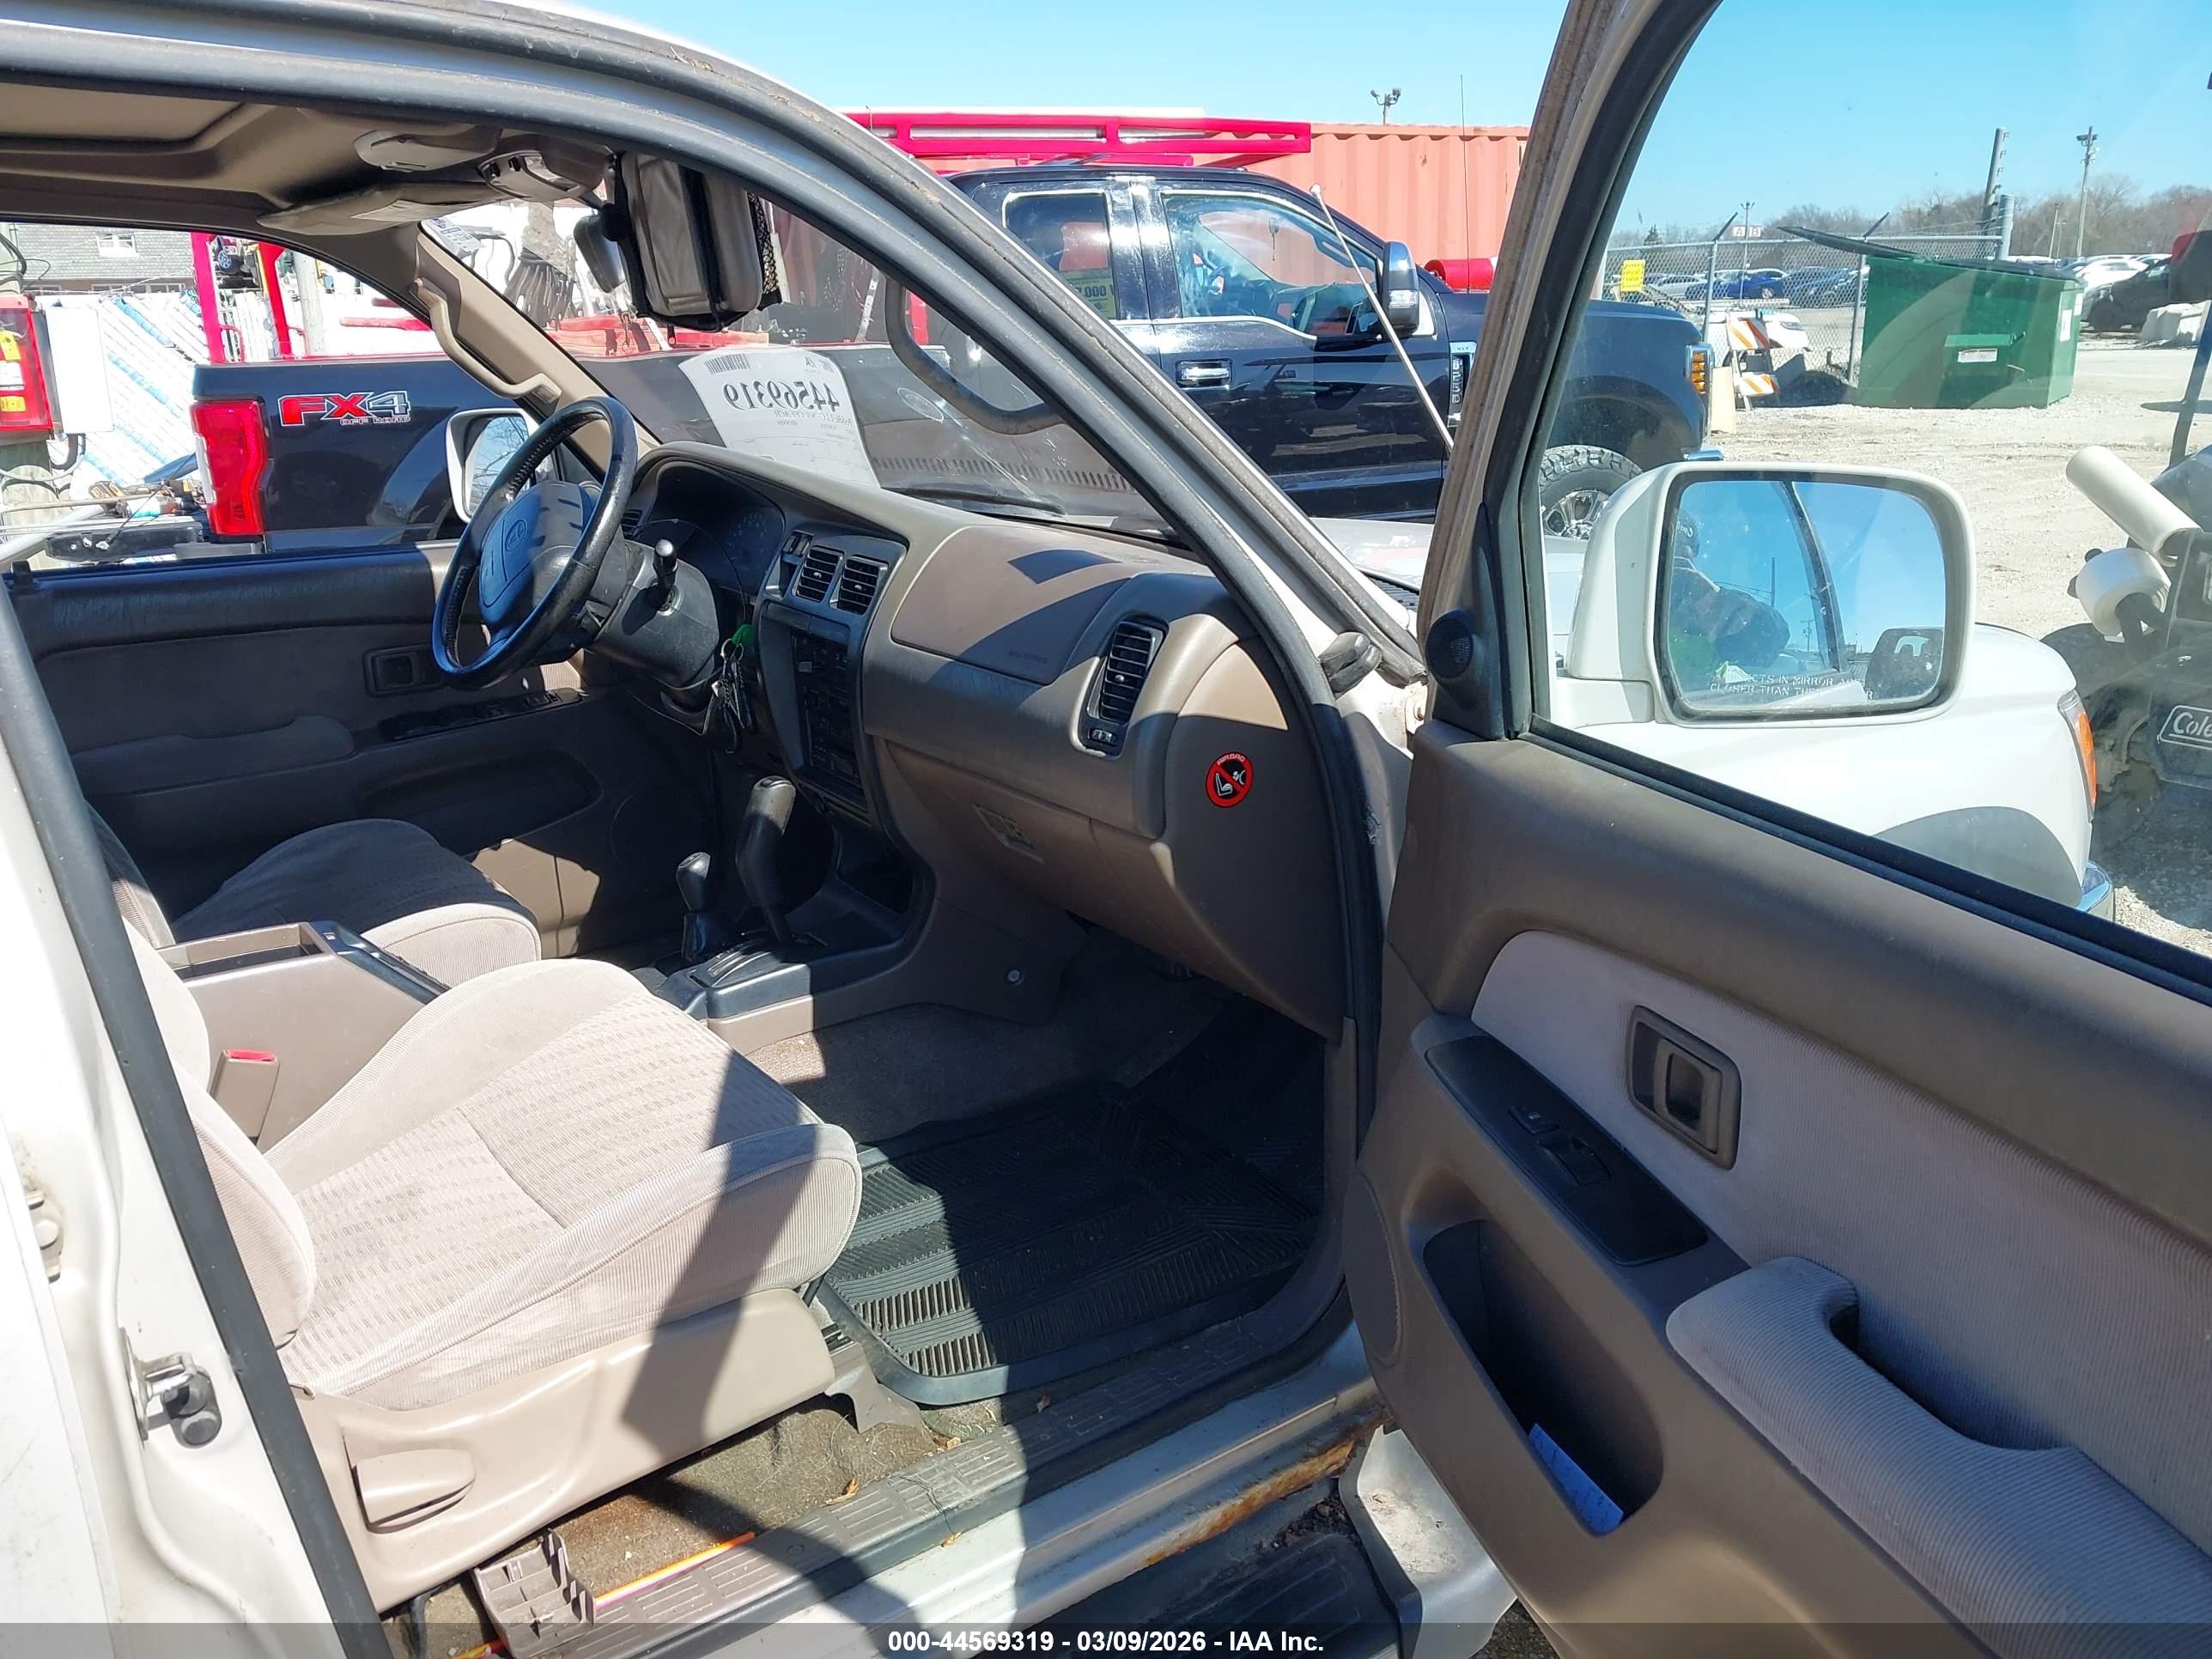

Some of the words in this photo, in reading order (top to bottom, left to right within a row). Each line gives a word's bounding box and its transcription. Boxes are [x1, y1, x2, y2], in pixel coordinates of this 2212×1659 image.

[277, 390, 411, 427] FX4
[339, 417, 368, 426] OFF
[373, 416, 411, 425] ROAD
[1778, 674, 1789, 685] IN
[1793, 675, 1833, 686] MIRROR
[1710, 683, 1755, 695] CLOSER
[1759, 685, 1790, 696] THAN
[1217, 753, 1246, 765] AIRBAG
